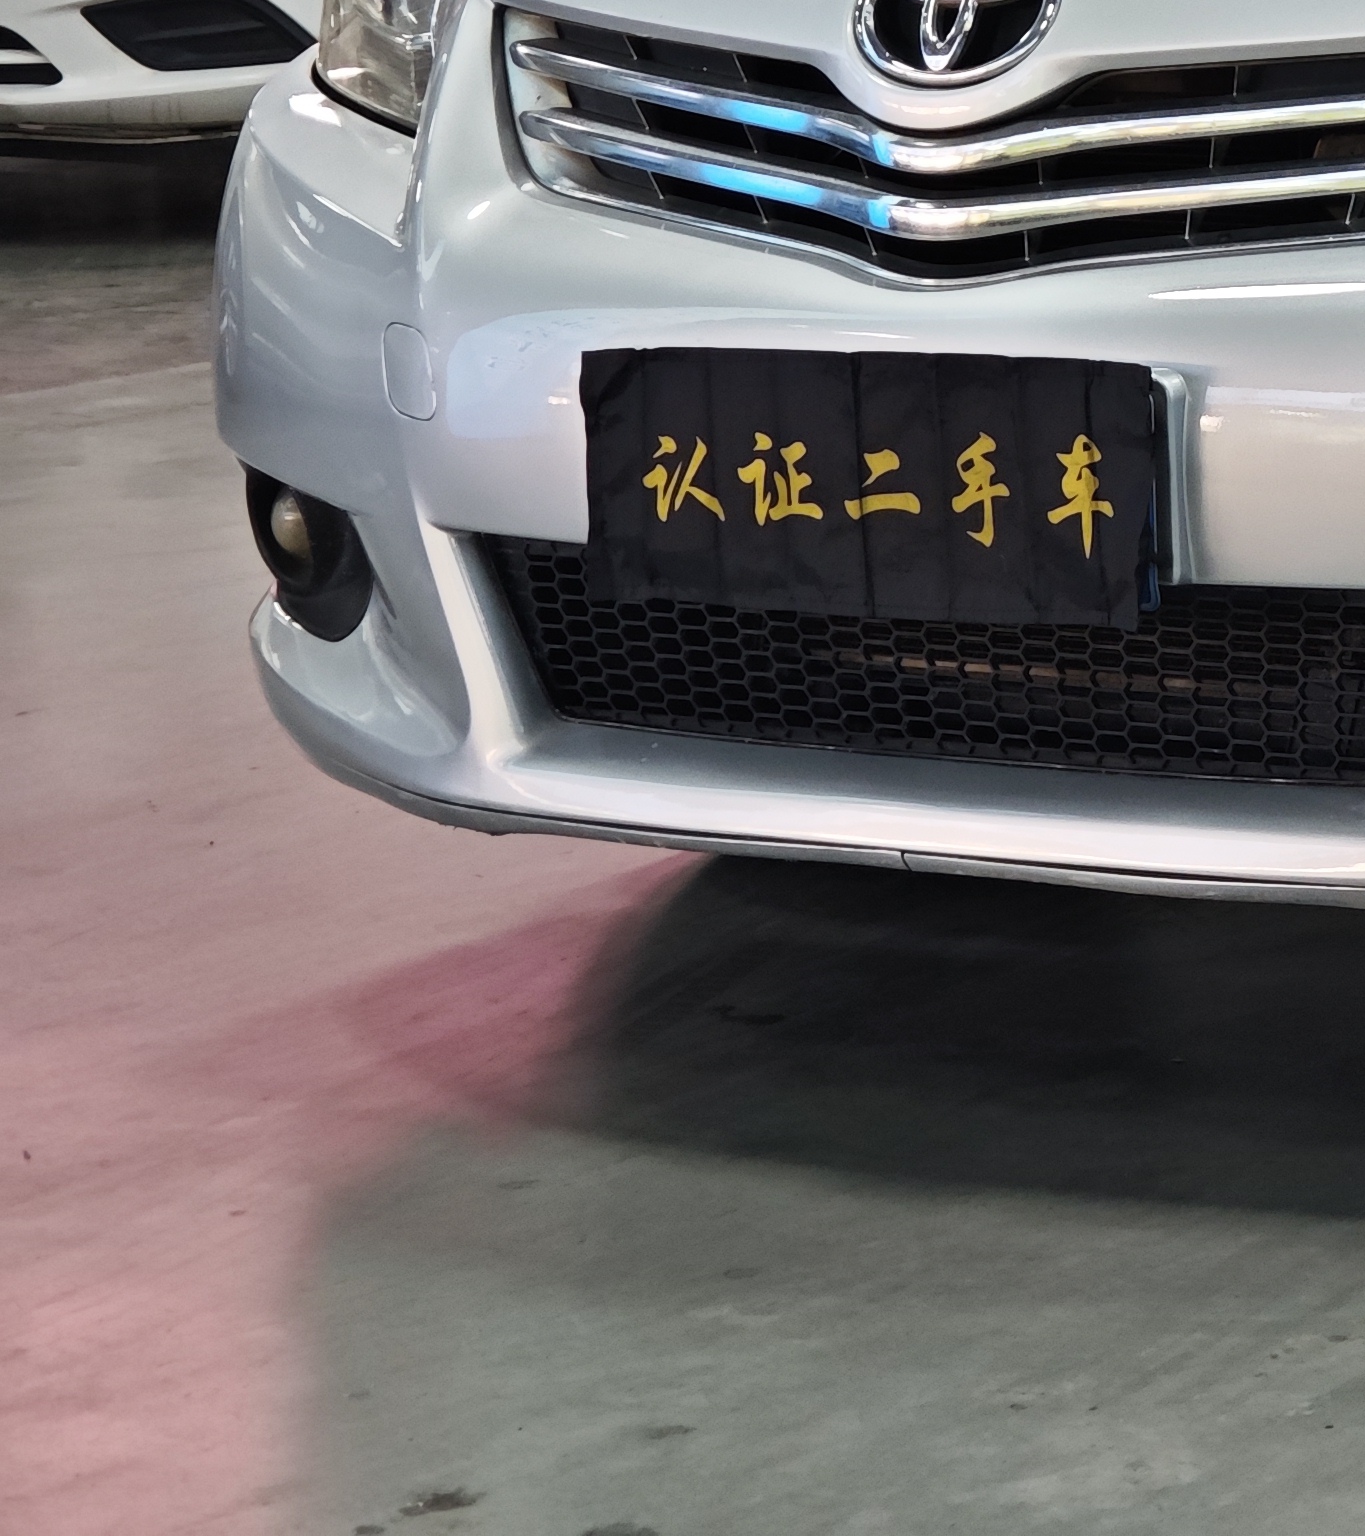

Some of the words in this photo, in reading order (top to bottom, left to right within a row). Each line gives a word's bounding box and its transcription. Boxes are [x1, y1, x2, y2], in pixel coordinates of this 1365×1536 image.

[642, 431, 1115, 560] 认证二手车
